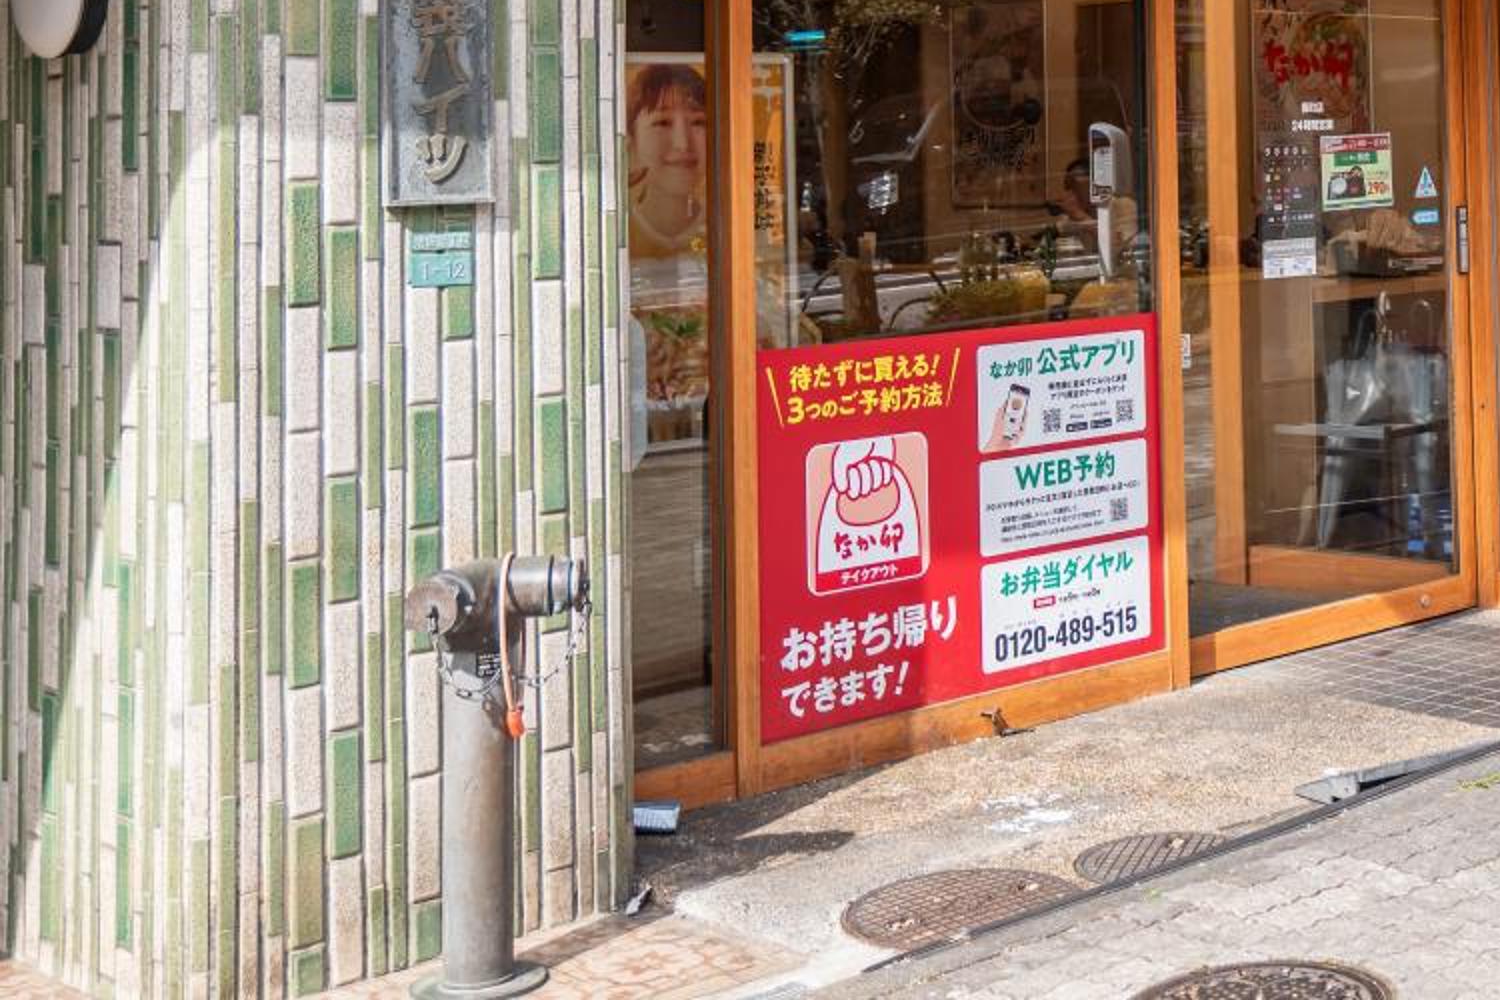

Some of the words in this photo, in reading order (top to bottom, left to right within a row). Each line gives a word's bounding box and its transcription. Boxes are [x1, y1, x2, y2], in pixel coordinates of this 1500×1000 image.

[1037, 339, 1136, 376] 公式アプリ
[787, 382, 943, 425] 3つのご予約方法
[1014, 449, 1116, 491] WEB予約
[834, 522, 904, 560] なか卯
[840, 563, 899, 585] テイクアウト
[1000, 551, 1134, 598] お弁当ダイヤル
[780, 595, 958, 673] お持ち帰り
[995, 606, 1138, 663] 0120-489-515
